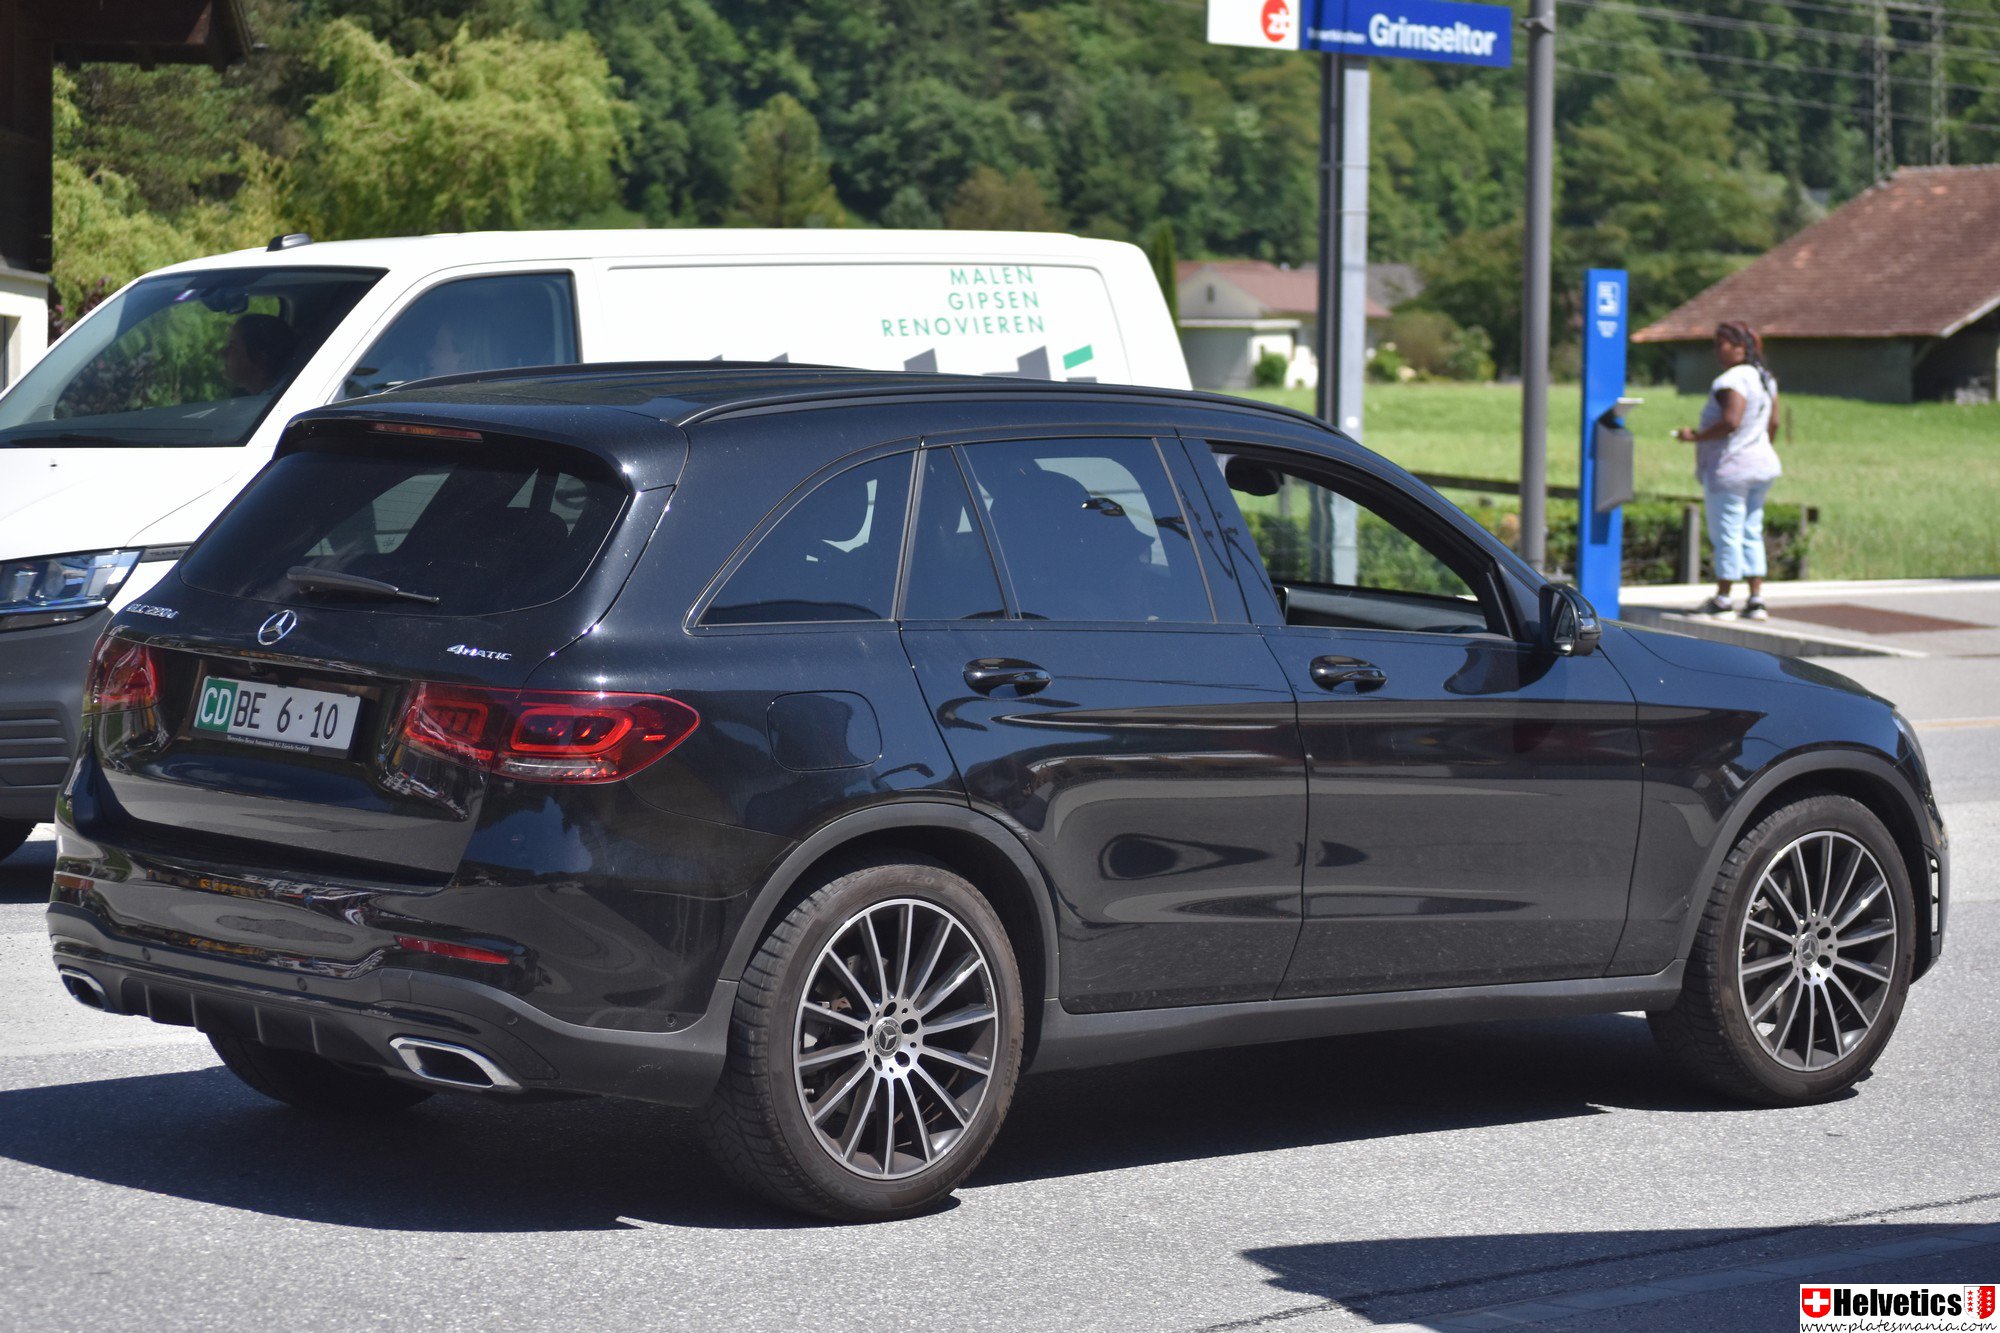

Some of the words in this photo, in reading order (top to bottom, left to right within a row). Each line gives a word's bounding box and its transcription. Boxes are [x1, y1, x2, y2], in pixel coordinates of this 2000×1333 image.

[1369, 13, 1497, 55] Grimseltor
[950, 265, 1033, 285] MALEN
[948, 291, 1039, 310] GIPSEN
[881, 315, 1045, 337] RENOVIEREN
[446, 644, 512, 660] 4MATIC
[200, 687, 232, 725] CD
[233, 690, 267, 729] BE
